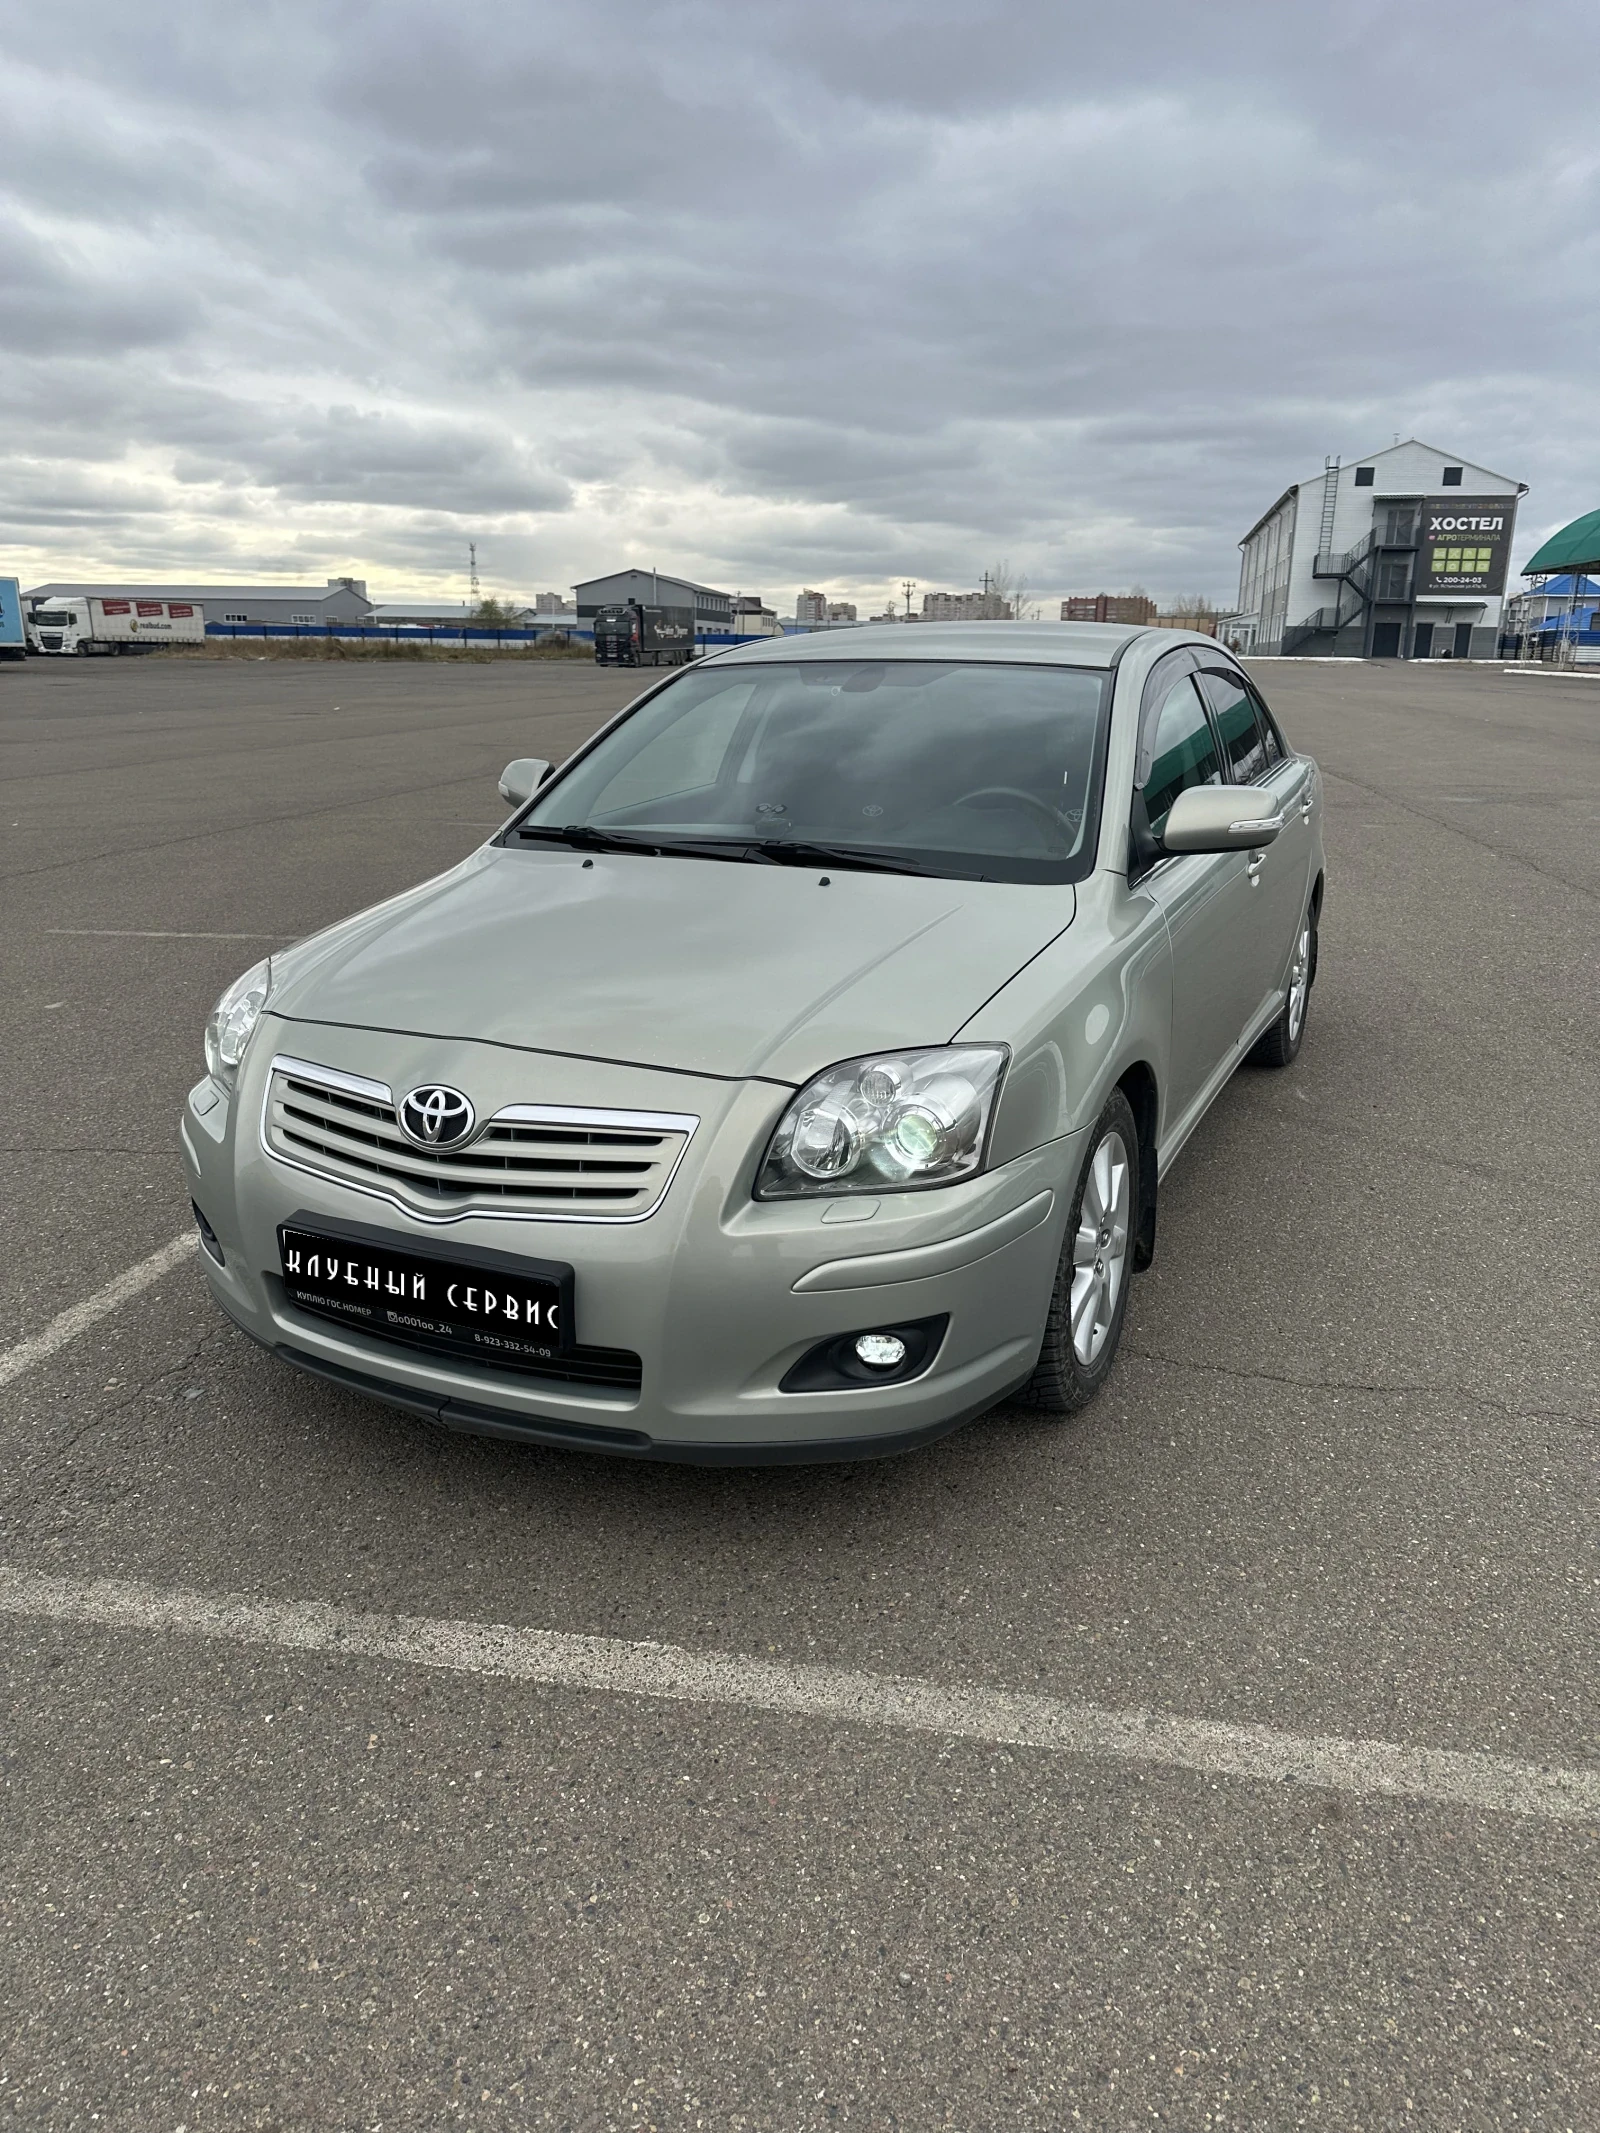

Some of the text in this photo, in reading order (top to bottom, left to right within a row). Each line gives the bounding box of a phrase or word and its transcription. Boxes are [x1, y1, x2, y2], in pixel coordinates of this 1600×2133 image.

[1429, 517, 1504, 530] ХОСТЕЛ
[140, 622, 172, 630] realbud.com
[297, 1290, 326, 1305] КУПЛЮ
[474, 1333, 551, 1357] 8-923-332-54-09
